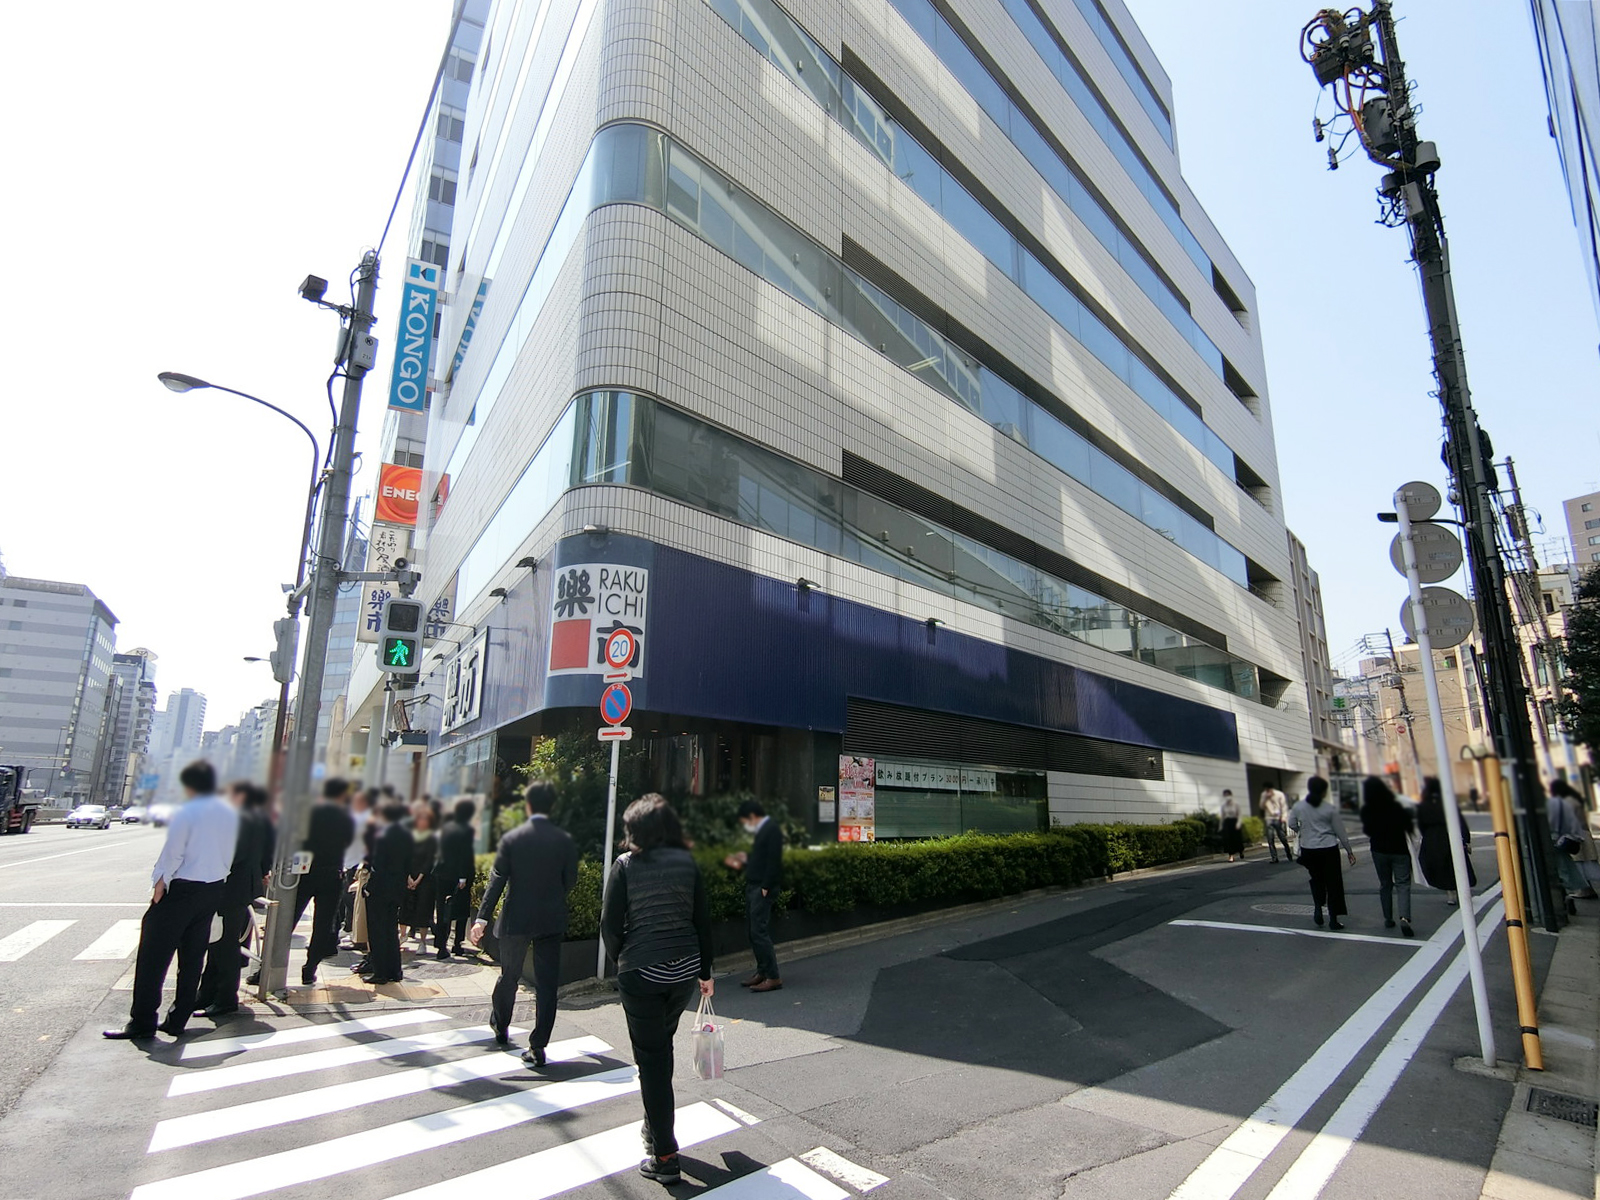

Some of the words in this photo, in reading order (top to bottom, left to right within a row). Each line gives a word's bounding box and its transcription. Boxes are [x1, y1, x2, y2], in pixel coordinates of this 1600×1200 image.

[397, 289, 430, 404] KONGO
[599, 568, 646, 594] RAKU
[598, 593, 644, 618] ICHI
[611, 640, 629, 658] 20
